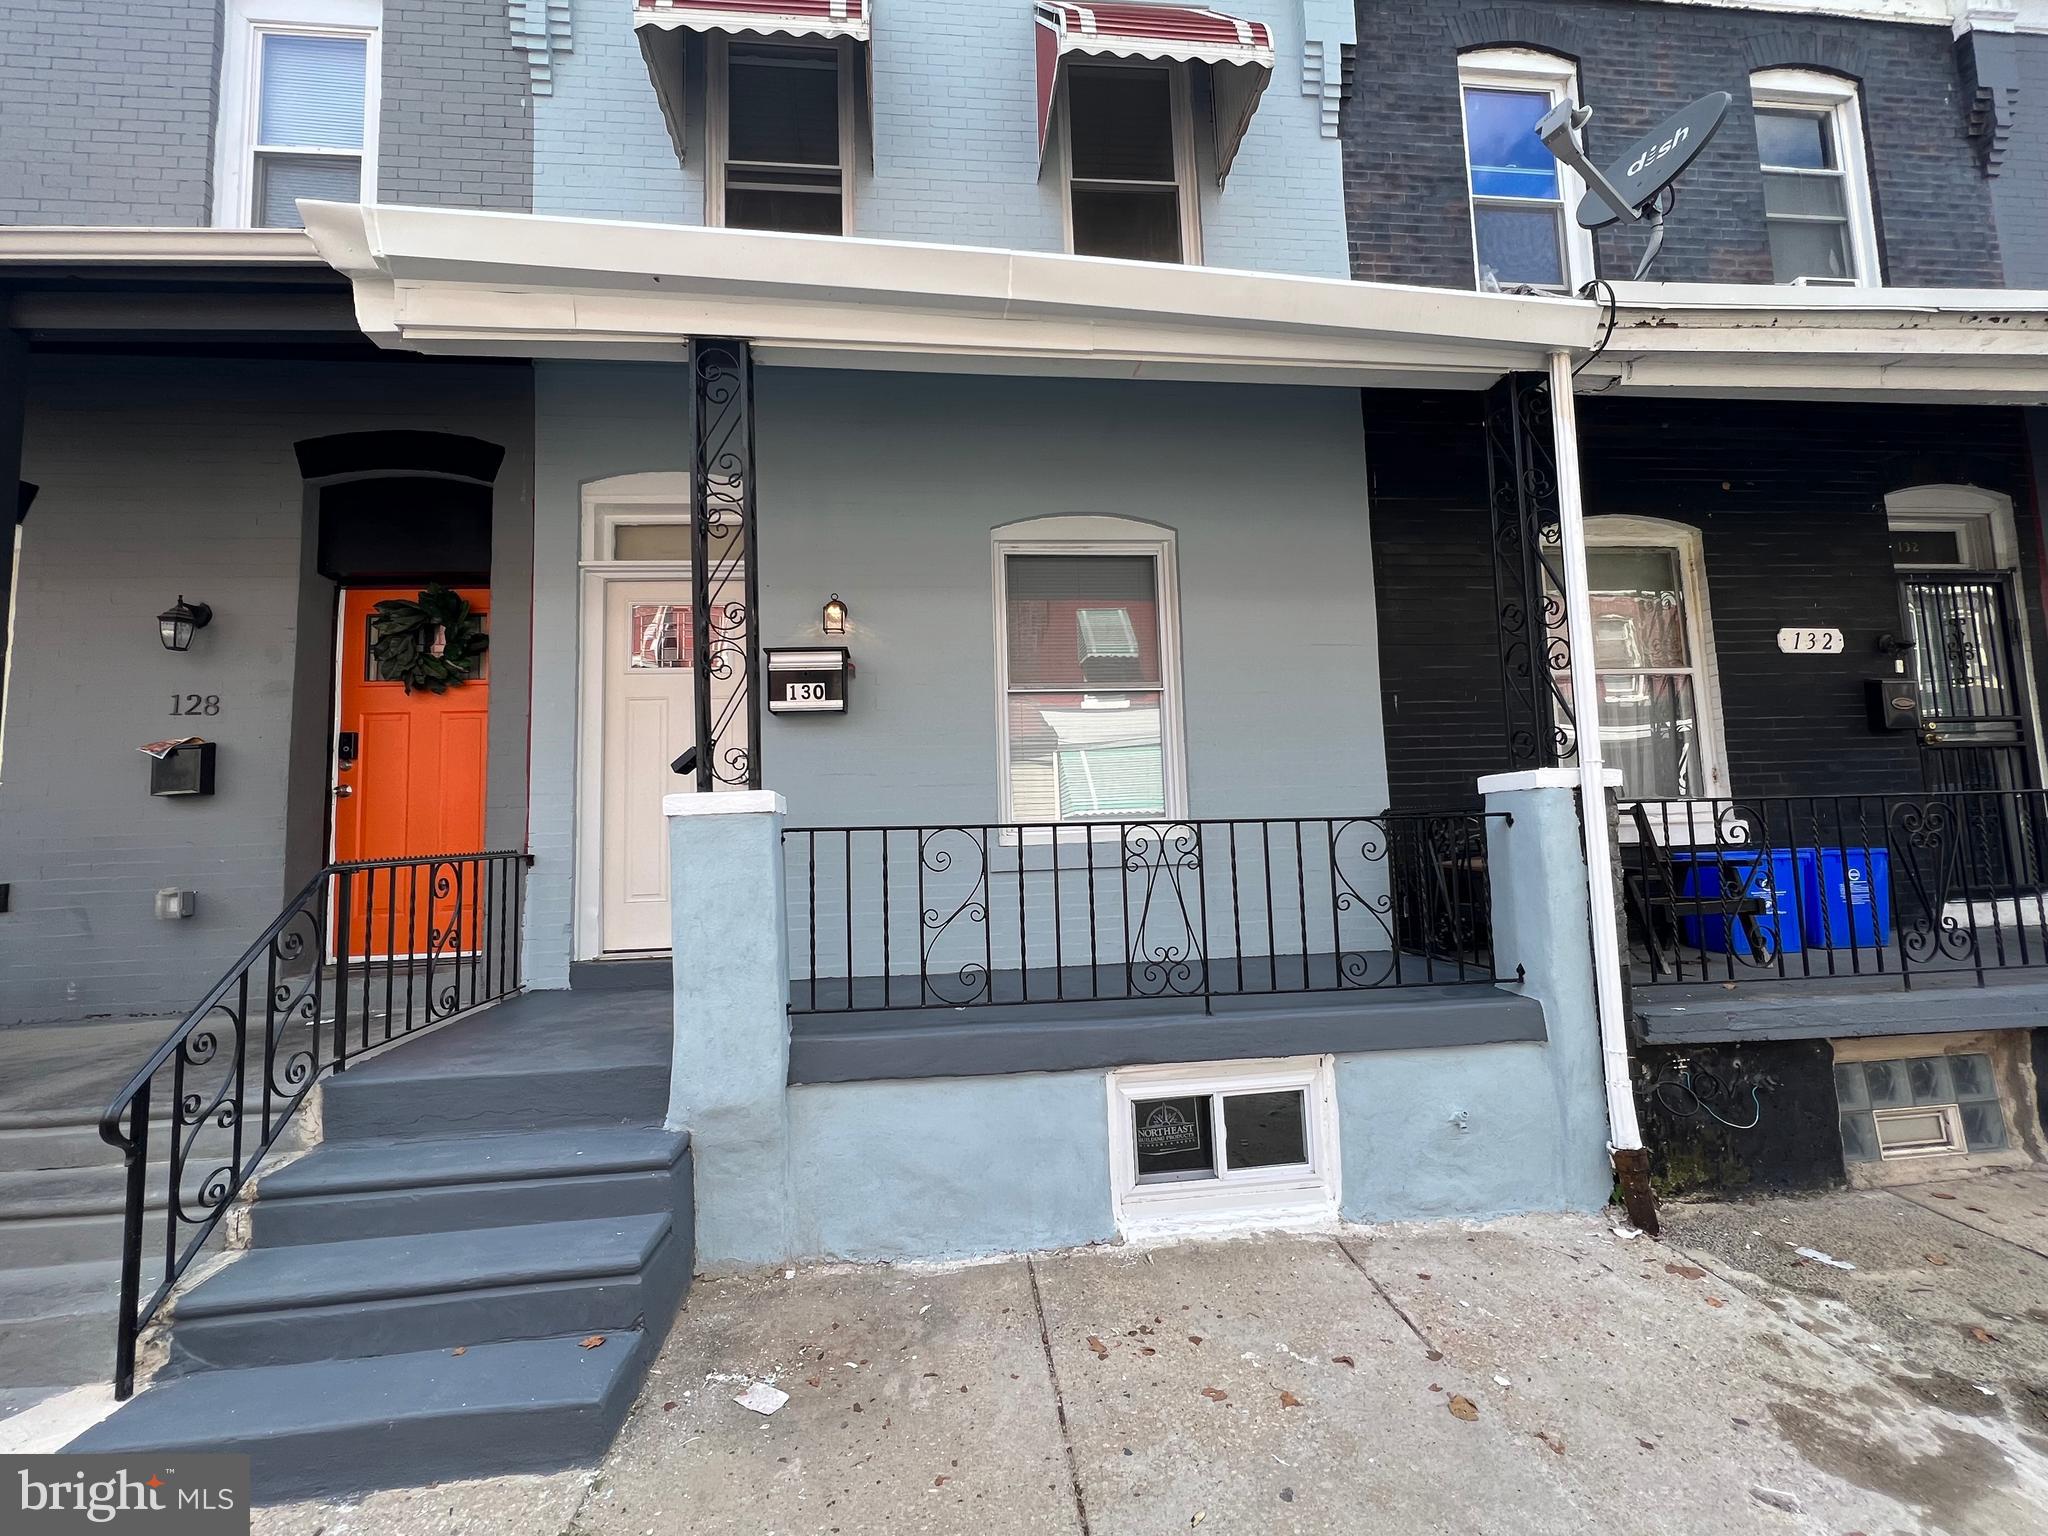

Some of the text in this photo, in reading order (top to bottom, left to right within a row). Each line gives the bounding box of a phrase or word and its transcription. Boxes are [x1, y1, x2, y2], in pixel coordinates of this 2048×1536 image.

[1627, 126, 1689, 177] dish
[1898, 542, 1920, 552] 132
[1794, 632, 1832, 650] 132
[789, 684, 824, 700] 130
[168, 694, 220, 716] 128
[1137, 1124, 1195, 1138] NORTHEAST
